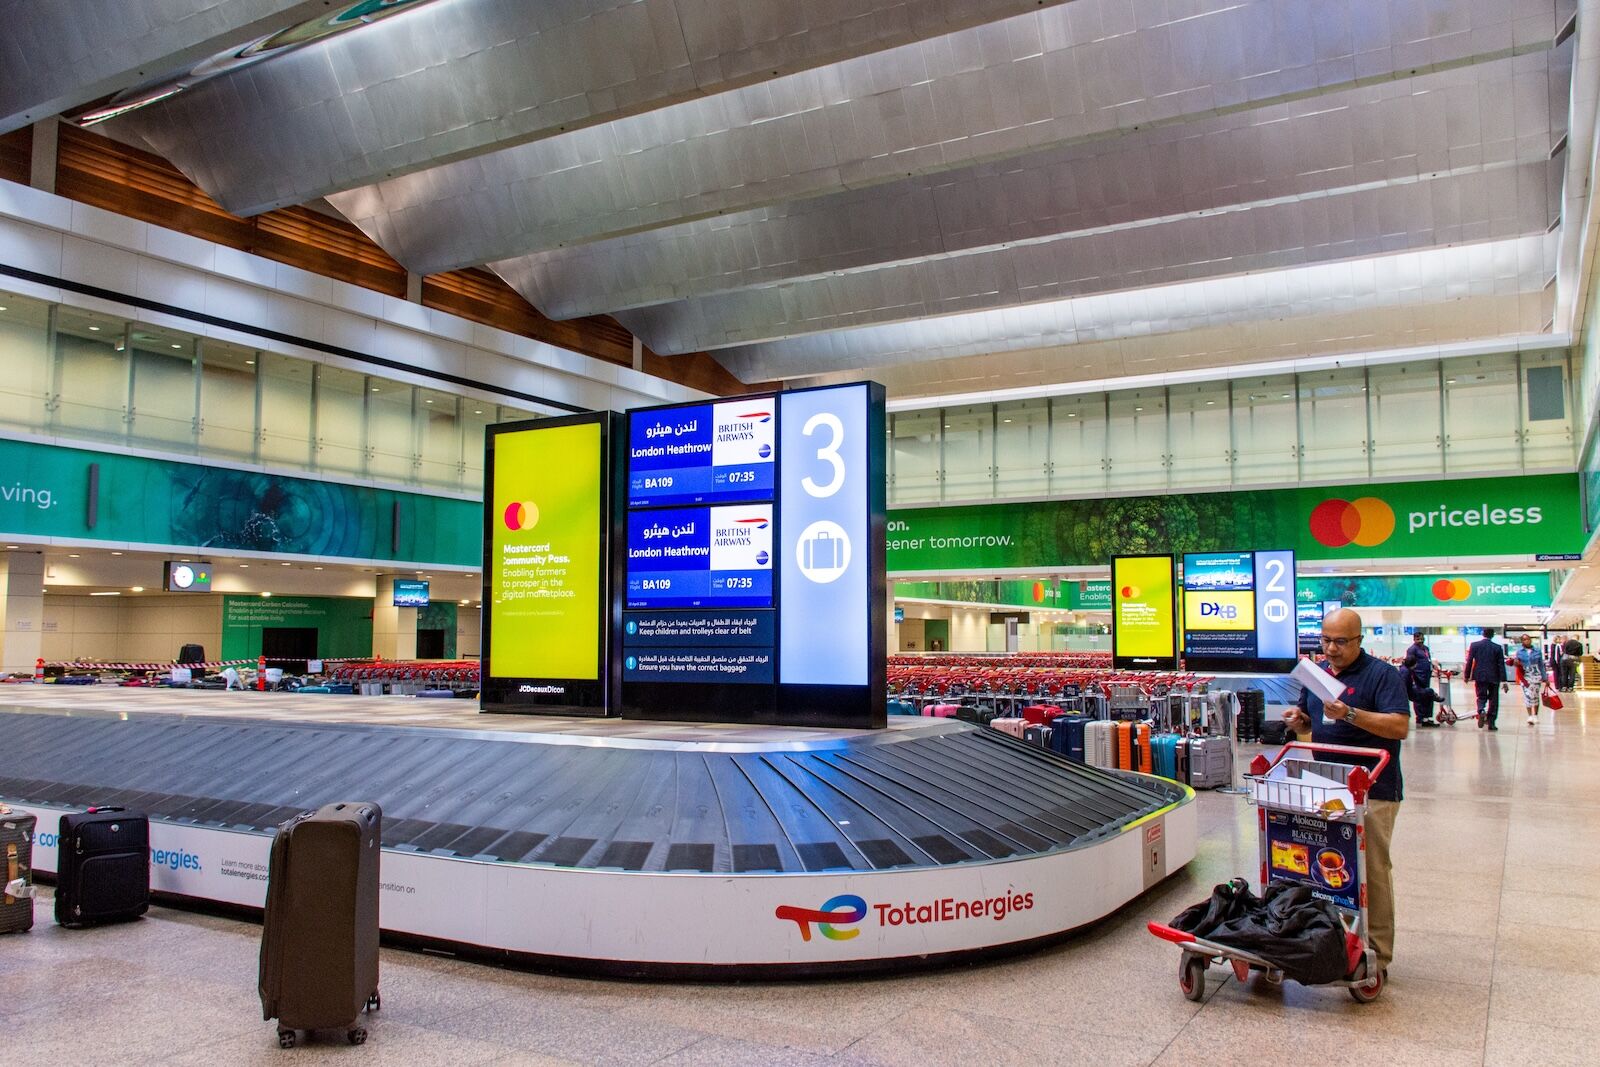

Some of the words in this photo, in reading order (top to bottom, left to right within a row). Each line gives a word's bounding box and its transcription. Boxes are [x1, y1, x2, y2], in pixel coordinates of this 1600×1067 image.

[646, 422, 672, 438] هيثرو
[675, 420, 697, 436] لندن
[718, 422, 753, 433] BRITISH
[717, 432, 754, 442] AIRWAYS
[631, 446, 664, 458] London
[667, 443, 712, 455] Heathrow
[801, 412, 845, 498] 3
[644, 477, 673, 489] BA109
[729, 471, 755, 483] 07:35
[1, 482, 57, 509] ving.
[1409, 503, 1542, 533] priceless
[643, 523, 670, 539] هيثرو
[672, 522, 695, 537] لندن
[887, 521, 910, 531] on.
[716, 528, 751, 537] BRITISH
[714, 536, 751, 546] AIRWAYS
[929, 535, 1015, 549] tomorrow.
[504, 542, 550, 553] Mastercard
[629, 547, 661, 558] London
[664, 545, 709, 557] Heathrow
[548, 554, 570, 563] Pass.
[503, 569, 534, 578] Enabling
[536, 567, 566, 577] farmers
[1264, 559, 1285, 592] 2
[503, 580, 510, 588] to
[512, 580, 540, 589] prosper
[542, 579, 548, 587] in
[550, 578, 563, 587] the
[643, 579, 671, 590] BA109
[727, 577, 752, 588] 07:35
[503, 590, 525, 600] digital
[527, 589, 576, 598] marketplace.
[1477, 583, 1536, 595] priceless
[639, 628, 654, 636] Keep
[692, 627, 713, 636] trolleys
[720, 664, 747, 673] baggage
[1291, 829, 1312, 841] BLACK
[1314, 833, 1328, 843] TEA
[151, 848, 202, 870] nergies.
[221, 858, 237, 867] Learn
[238, 862, 253, 870] more
[406, 886, 416, 894] on
[873, 889, 1034, 927] TotalEnergies
